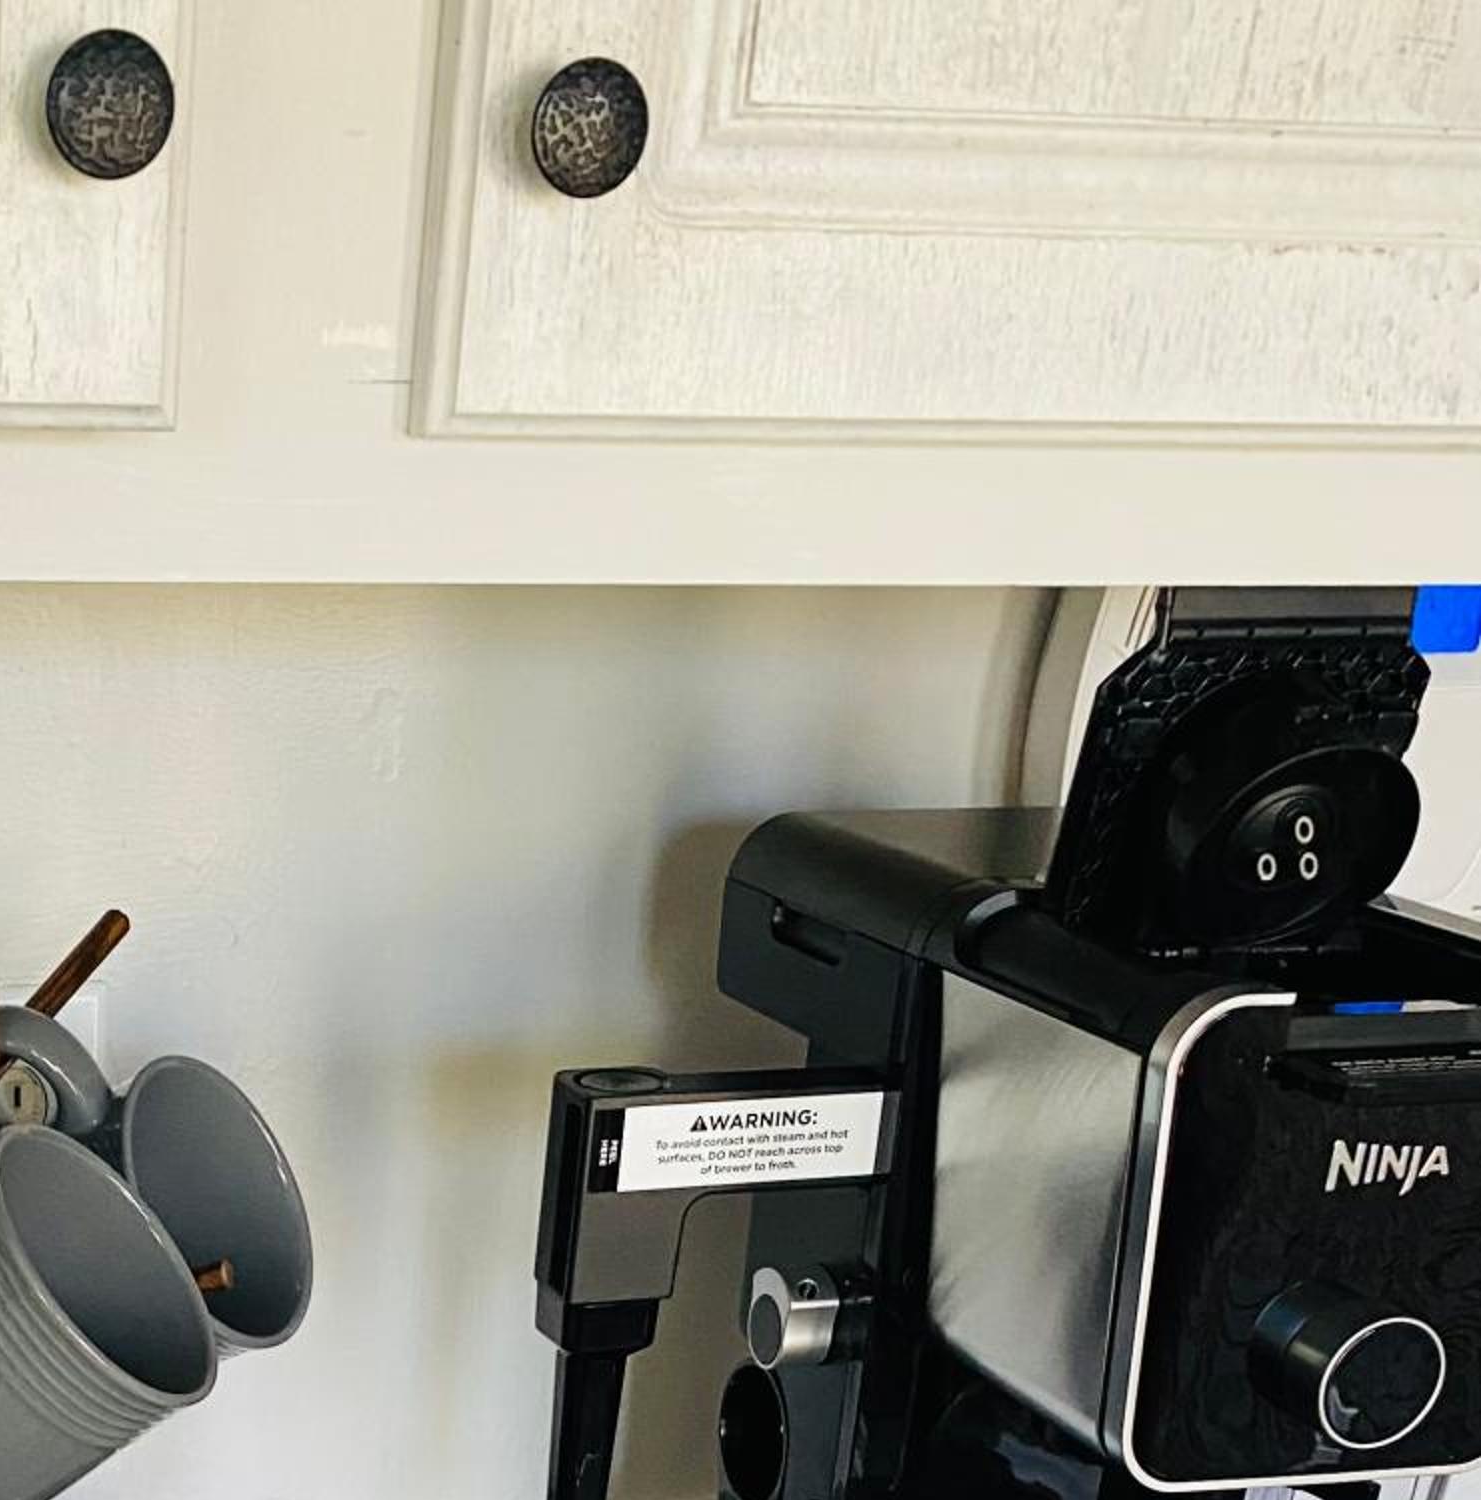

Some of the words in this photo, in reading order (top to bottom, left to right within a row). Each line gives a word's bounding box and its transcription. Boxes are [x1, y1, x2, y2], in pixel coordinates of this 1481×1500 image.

[709, 1109, 818, 1131] WARNING:
[671, 1137, 701, 1149] avoid
[703, 1136, 744, 1147] contact
[747, 1133, 770, 1144] with
[773, 1132, 805, 1143] steam
[808, 1129, 828, 1140] and
[831, 1129, 848, 1140] hot
[708, 1149, 725, 1161] DO
[729, 1147, 753, 1159] NOT
[714, 1162, 752, 1174] brewer
[755, 1160, 766, 1171] to
[1324, 1139, 1450, 1197] NINJA
